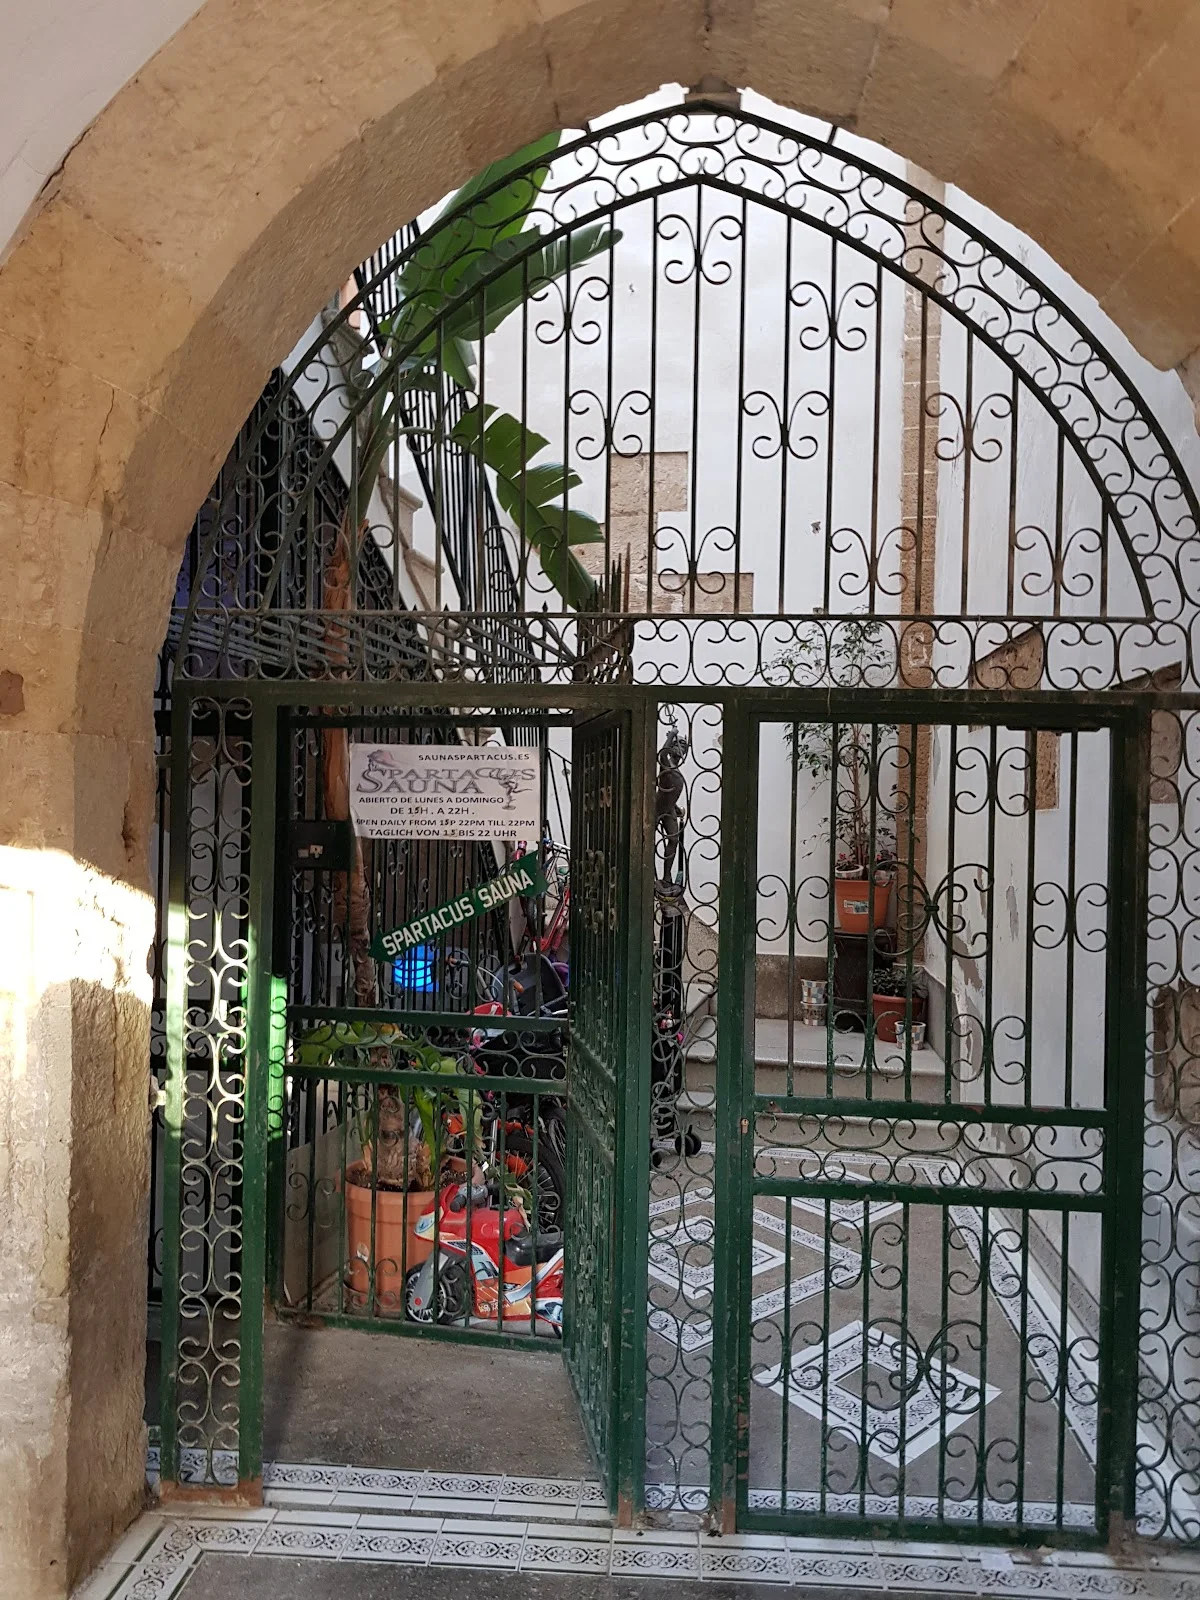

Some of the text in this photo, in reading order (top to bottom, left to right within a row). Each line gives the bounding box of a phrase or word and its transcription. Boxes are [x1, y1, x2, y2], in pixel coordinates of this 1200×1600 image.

[418, 753, 530, 761] SAUNASPARTACUS.ES
[356, 779, 484, 794] SAUNA
[359, 796, 398, 804] ABIERTO
[400, 796, 413, 804] DE
[390, 807, 404, 815] DE
[437, 807, 445, 815] A
[356, 818, 378, 826] OPEN
[458, 819, 485, 827] 22PM
[368, 829, 413, 837] TAGLICH
[416, 829, 440, 837] VON
[458, 829, 475, 837] BIS
[477, 829, 491, 837] 22
[381, 868, 534, 956] SPARTACUS SAUNA
